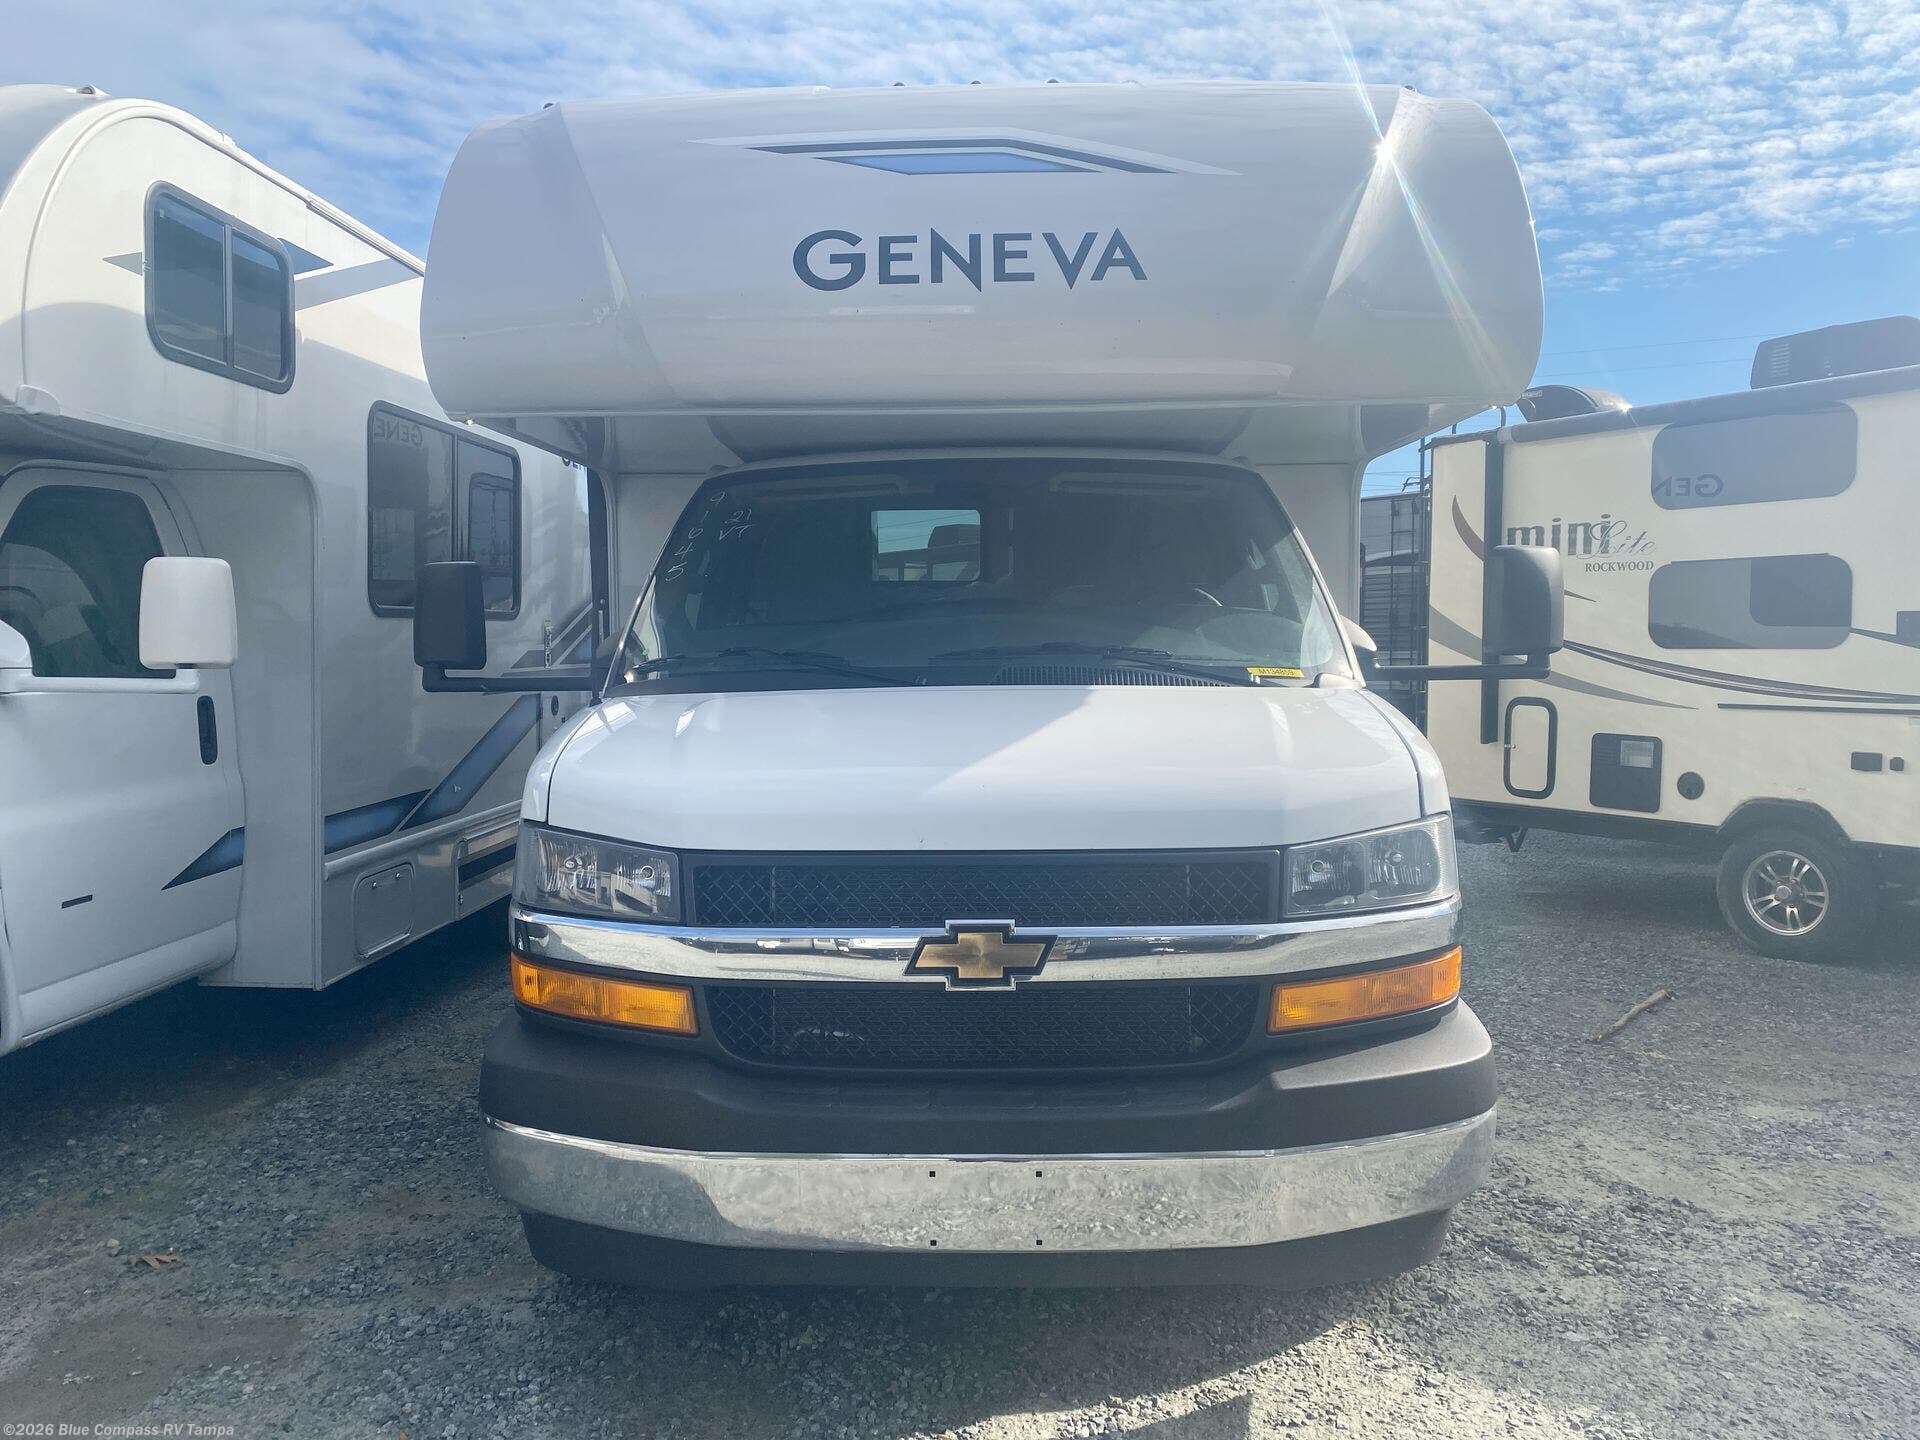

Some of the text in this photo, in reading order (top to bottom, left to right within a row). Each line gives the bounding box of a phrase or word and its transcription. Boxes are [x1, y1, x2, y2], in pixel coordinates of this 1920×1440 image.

[793, 228, 1147, 292] GENEVA
[1507, 513, 1657, 559] mini Lite
[1585, 561, 1655, 573] ROCKWOOD
